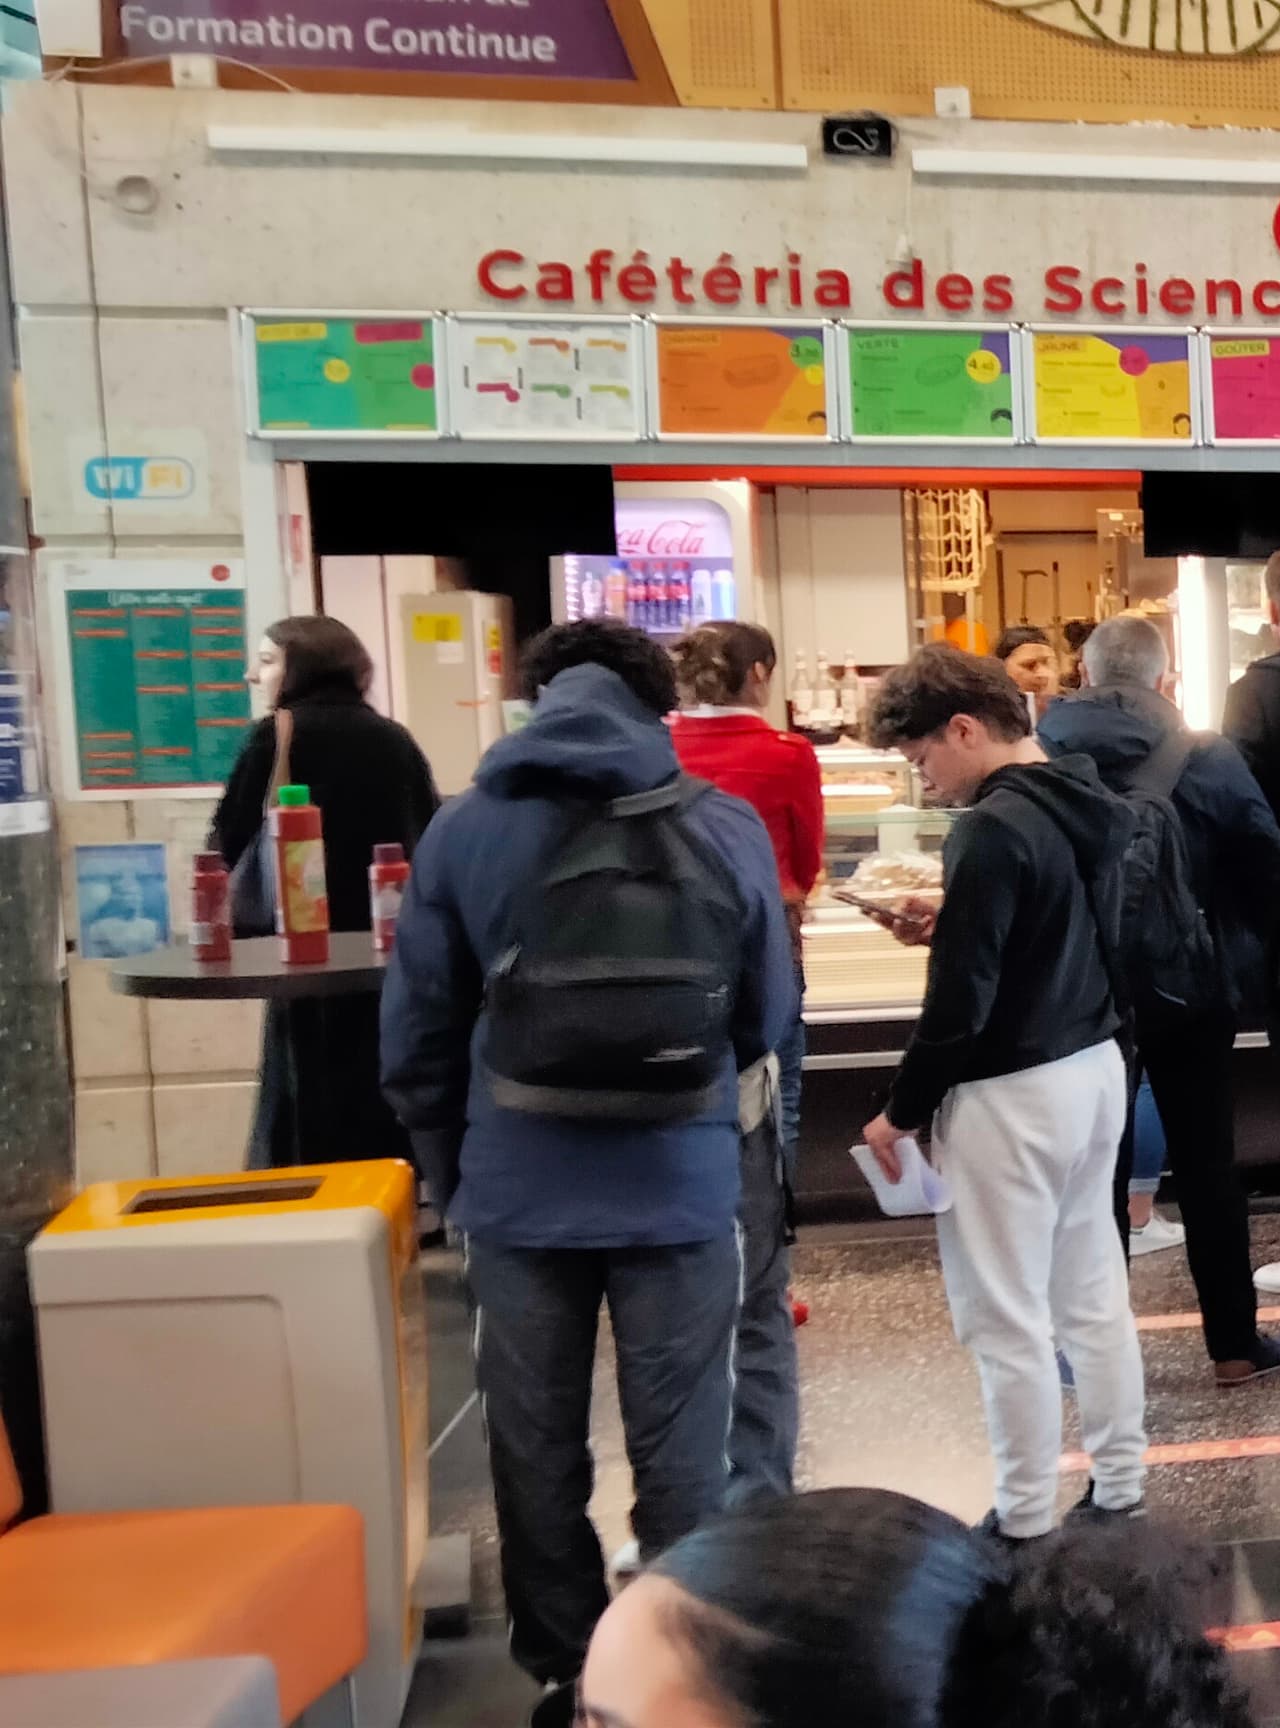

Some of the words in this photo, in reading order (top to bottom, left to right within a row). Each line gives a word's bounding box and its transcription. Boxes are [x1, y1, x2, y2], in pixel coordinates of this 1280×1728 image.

[119, 4, 353, 53] Formation
[364, 17, 557, 63] Continue
[476, 248, 851, 308] Cafétéria
[881, 257, 1014, 313] des
